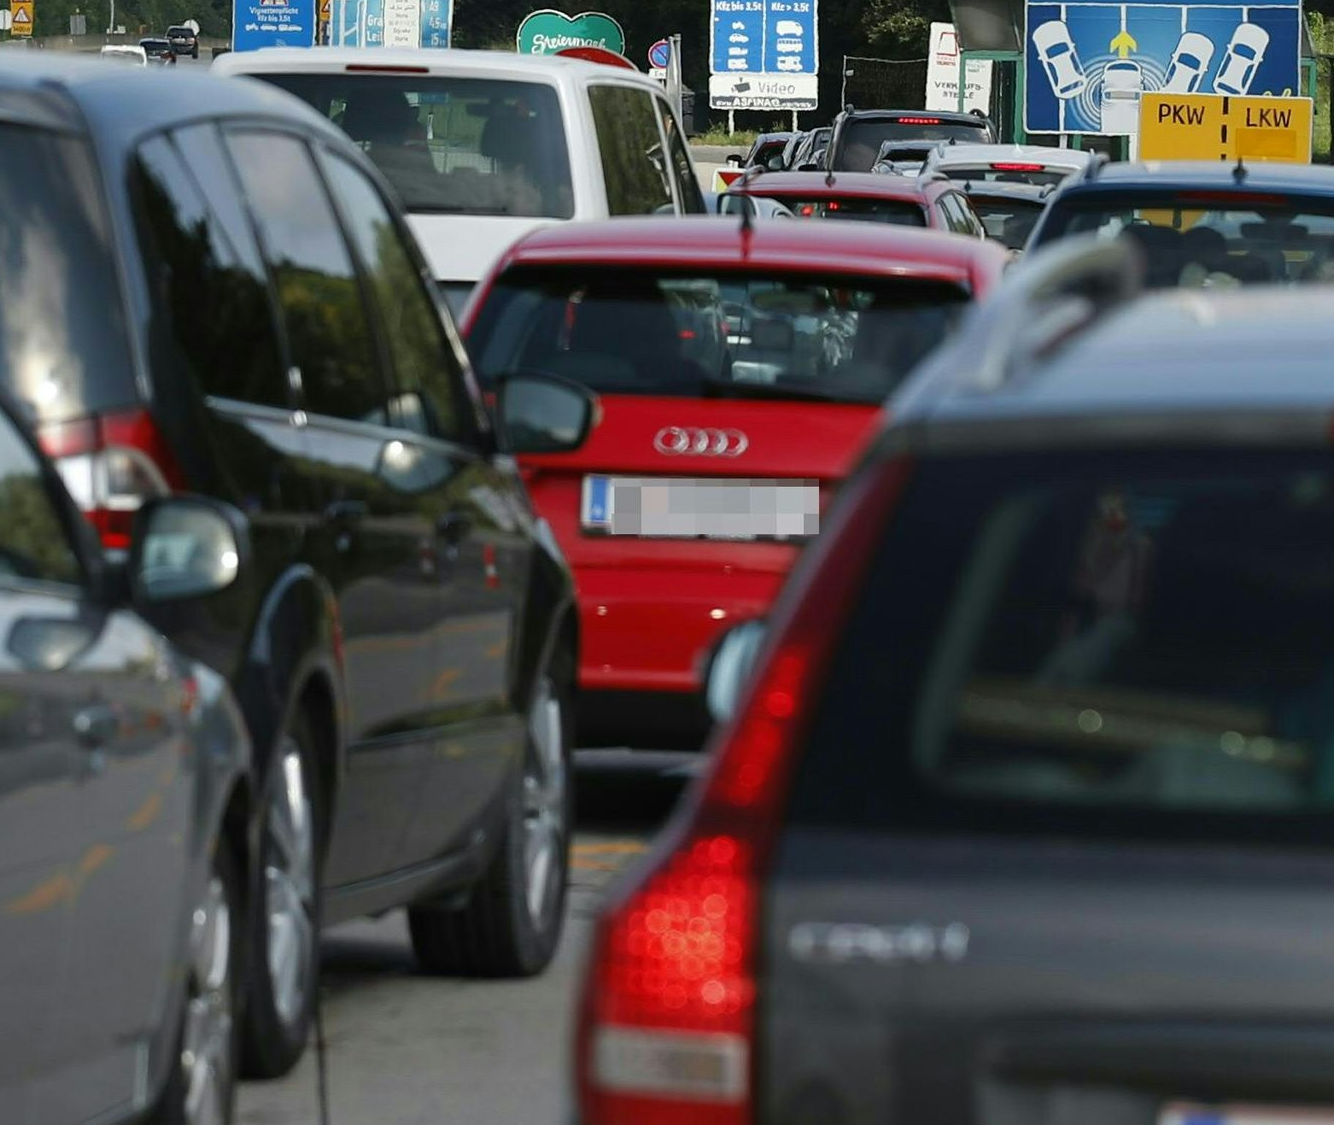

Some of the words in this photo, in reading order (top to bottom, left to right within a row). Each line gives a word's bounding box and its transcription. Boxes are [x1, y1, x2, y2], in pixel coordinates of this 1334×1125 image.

[731, 1, 744, 11] bis
[367, 14, 382, 27] Gra
[758, 81, 796, 95] Video
[934, 81, 984, 91] VERKUFS-
[1158, 104, 1205, 125] PKW
[1246, 107, 1291, 128] LKW
